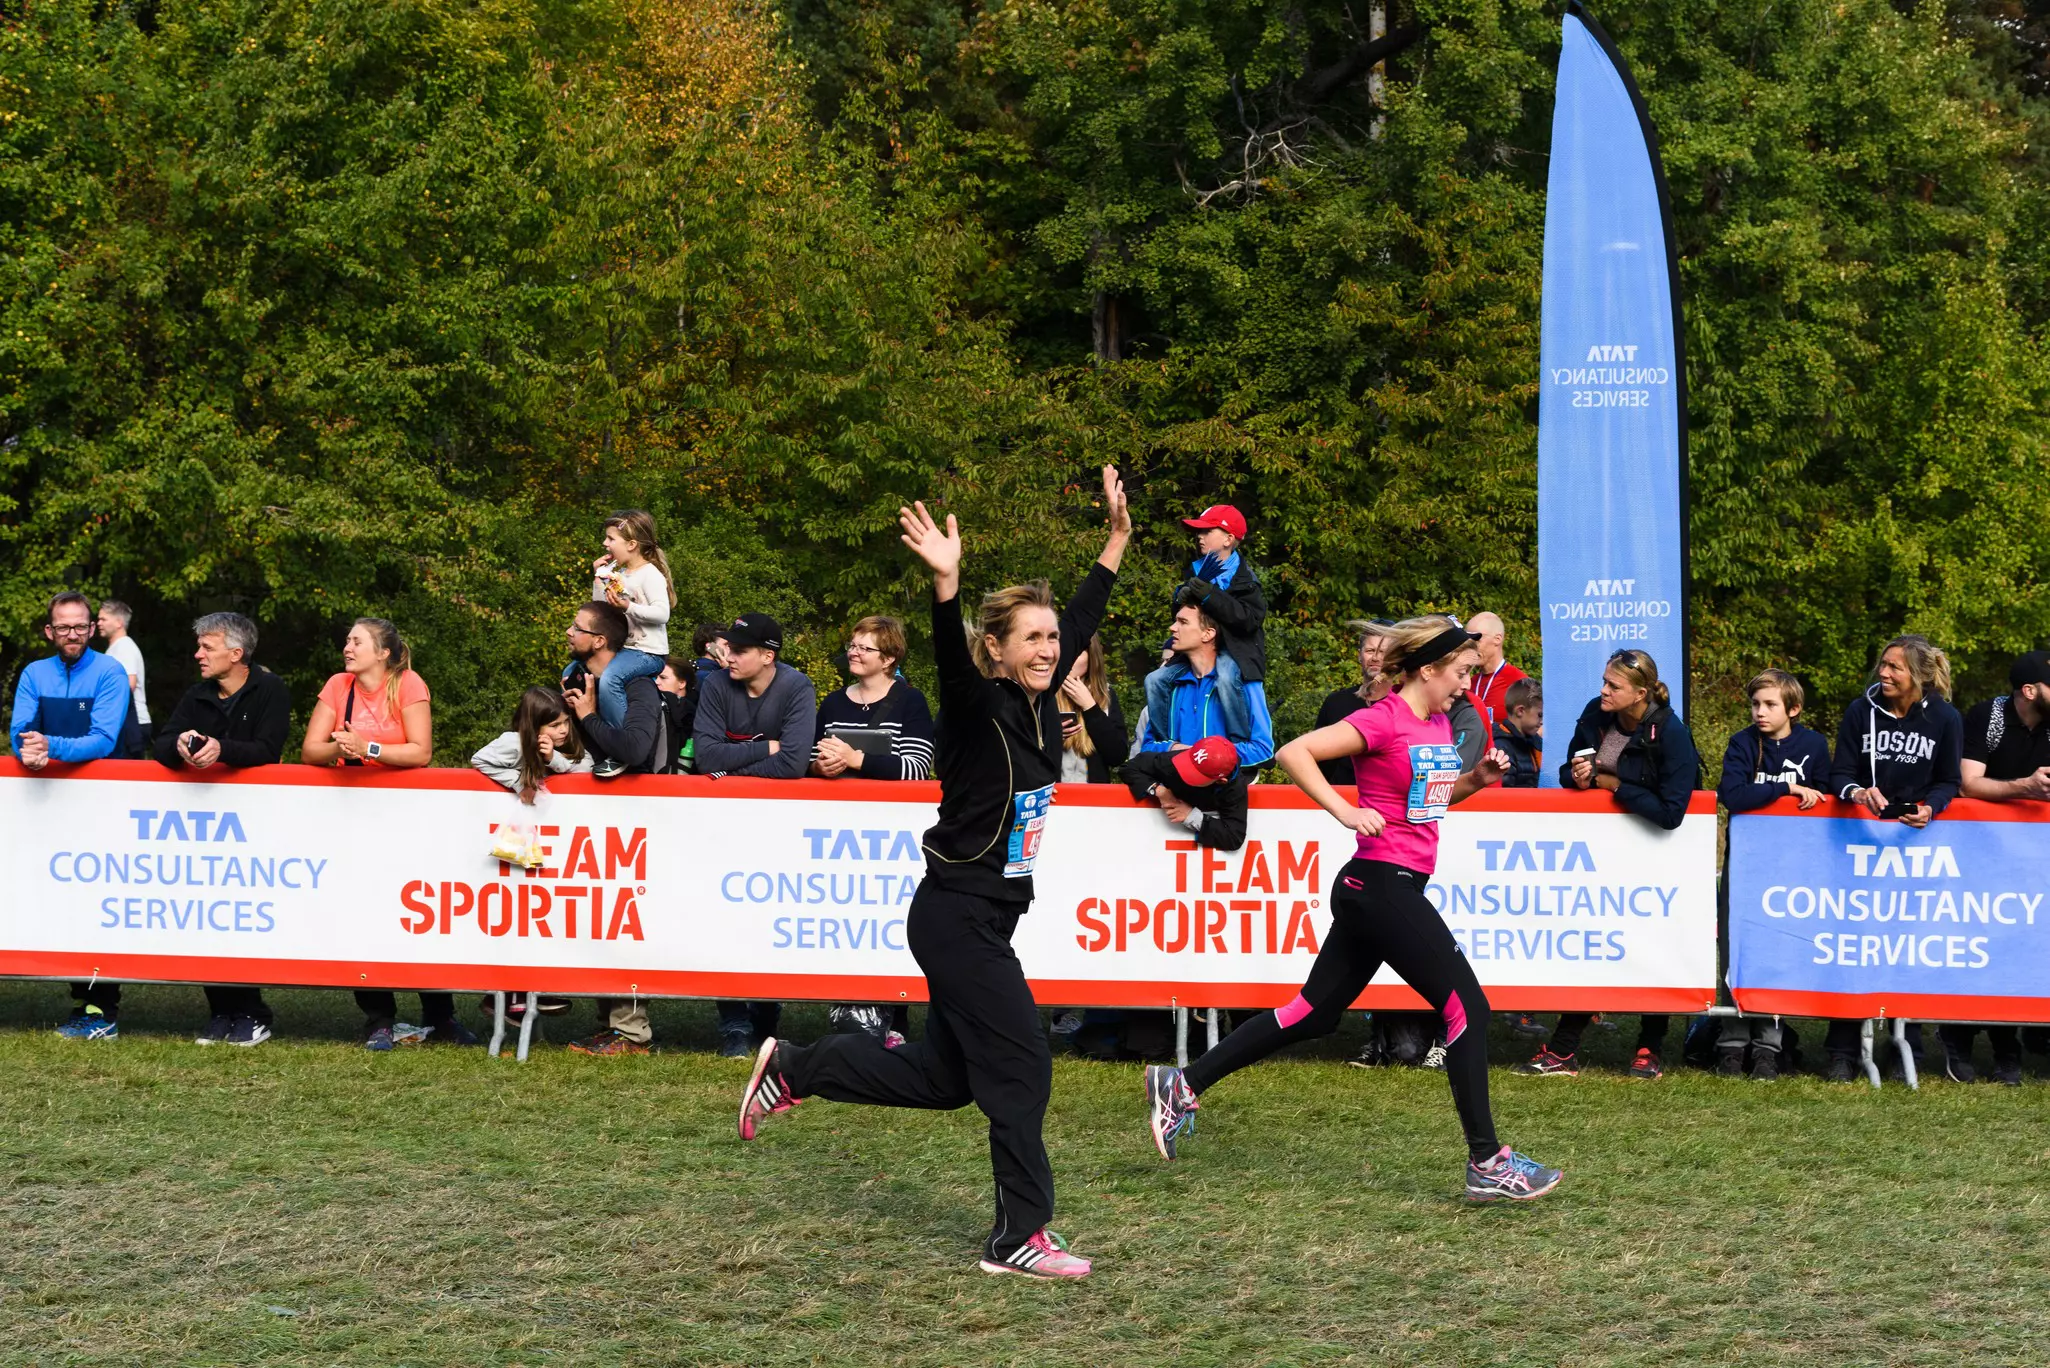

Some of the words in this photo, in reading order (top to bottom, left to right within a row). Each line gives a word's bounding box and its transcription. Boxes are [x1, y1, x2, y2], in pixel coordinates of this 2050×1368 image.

[1895, 753, 1918, 764] 1938
[130, 809, 248, 842] TATA
[1020, 809, 1036, 820] TATA
[803, 828, 921, 861] TATA
[1477, 840, 1597, 872] TATA
[1846, 844, 1961, 878] TATA
[49, 851, 328, 889] CONSULTANCY
[1165, 840, 1320, 893] TEAM
[721, 871, 917, 905] CONSULTA
[1423, 883, 1679, 917] ONSULTANCY
[1761, 885, 2044, 925] CONSULTANCY
[101, 897, 275, 932] SERVICES
[773, 917, 905, 950] SERVIC
[1812, 932, 1990, 969] SERVICES
